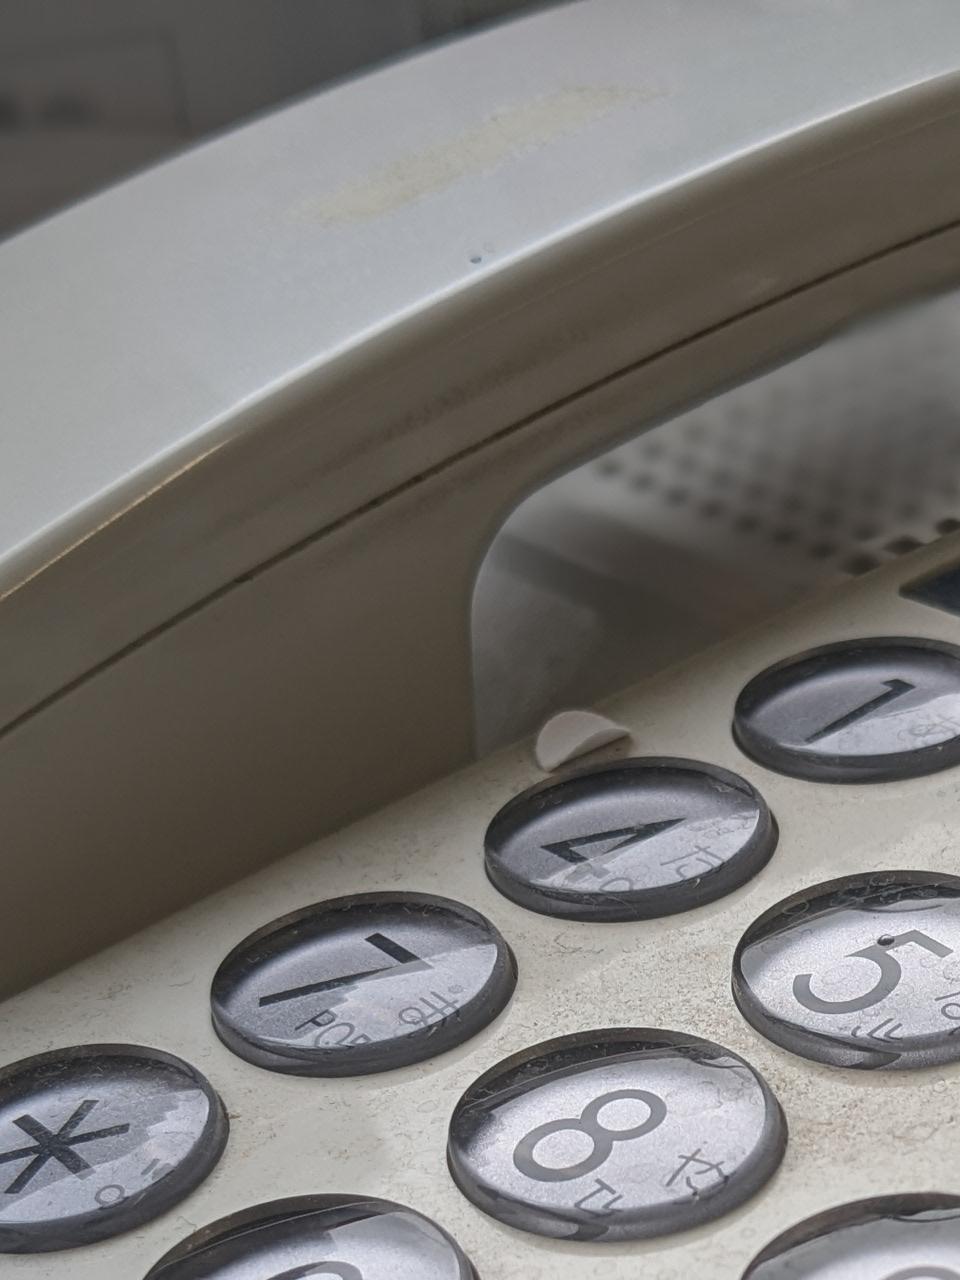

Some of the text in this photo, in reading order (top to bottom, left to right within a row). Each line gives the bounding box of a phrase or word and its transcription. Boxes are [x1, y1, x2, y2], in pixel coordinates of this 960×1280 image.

[804, 677, 917, 746] 1
[539, 817, 688, 885] 4
[257, 932, 435, 1008] 7
[792, 928, 955, 1015] 5
[512, 1088, 668, 1183] 8
